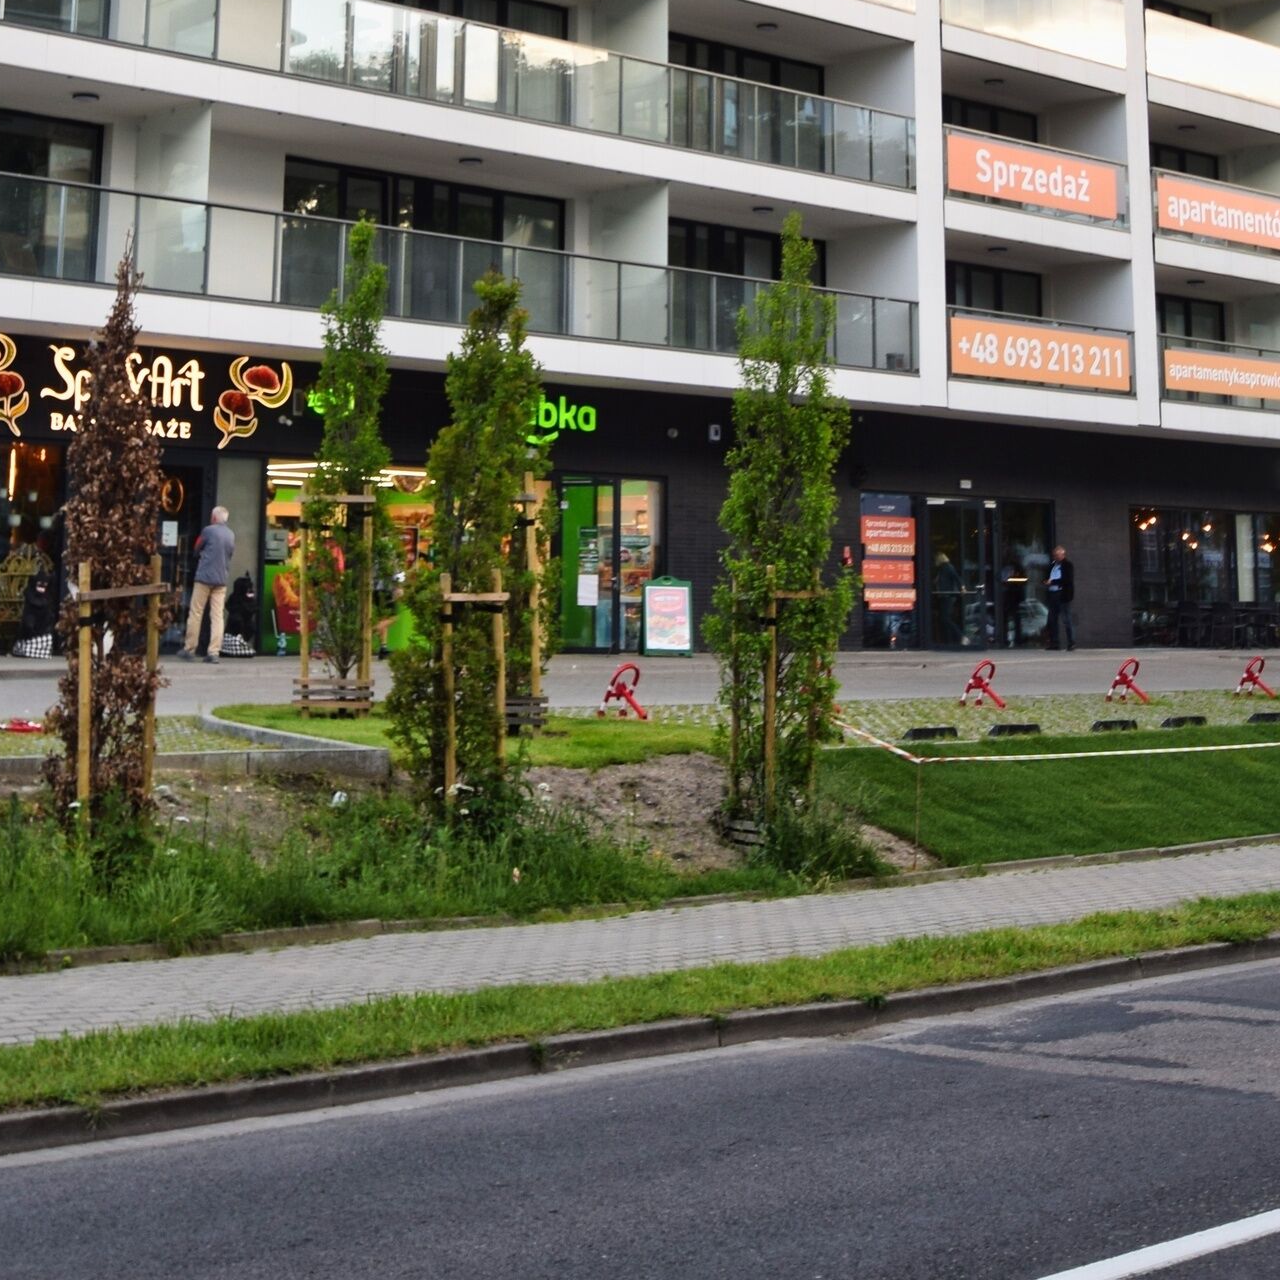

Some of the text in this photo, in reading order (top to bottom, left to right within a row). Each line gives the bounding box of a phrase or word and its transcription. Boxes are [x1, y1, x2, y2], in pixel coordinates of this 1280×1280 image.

[975, 148, 1090, 202] Sprzedaż
[958, 332, 1123, 378] +48 693 213 211
